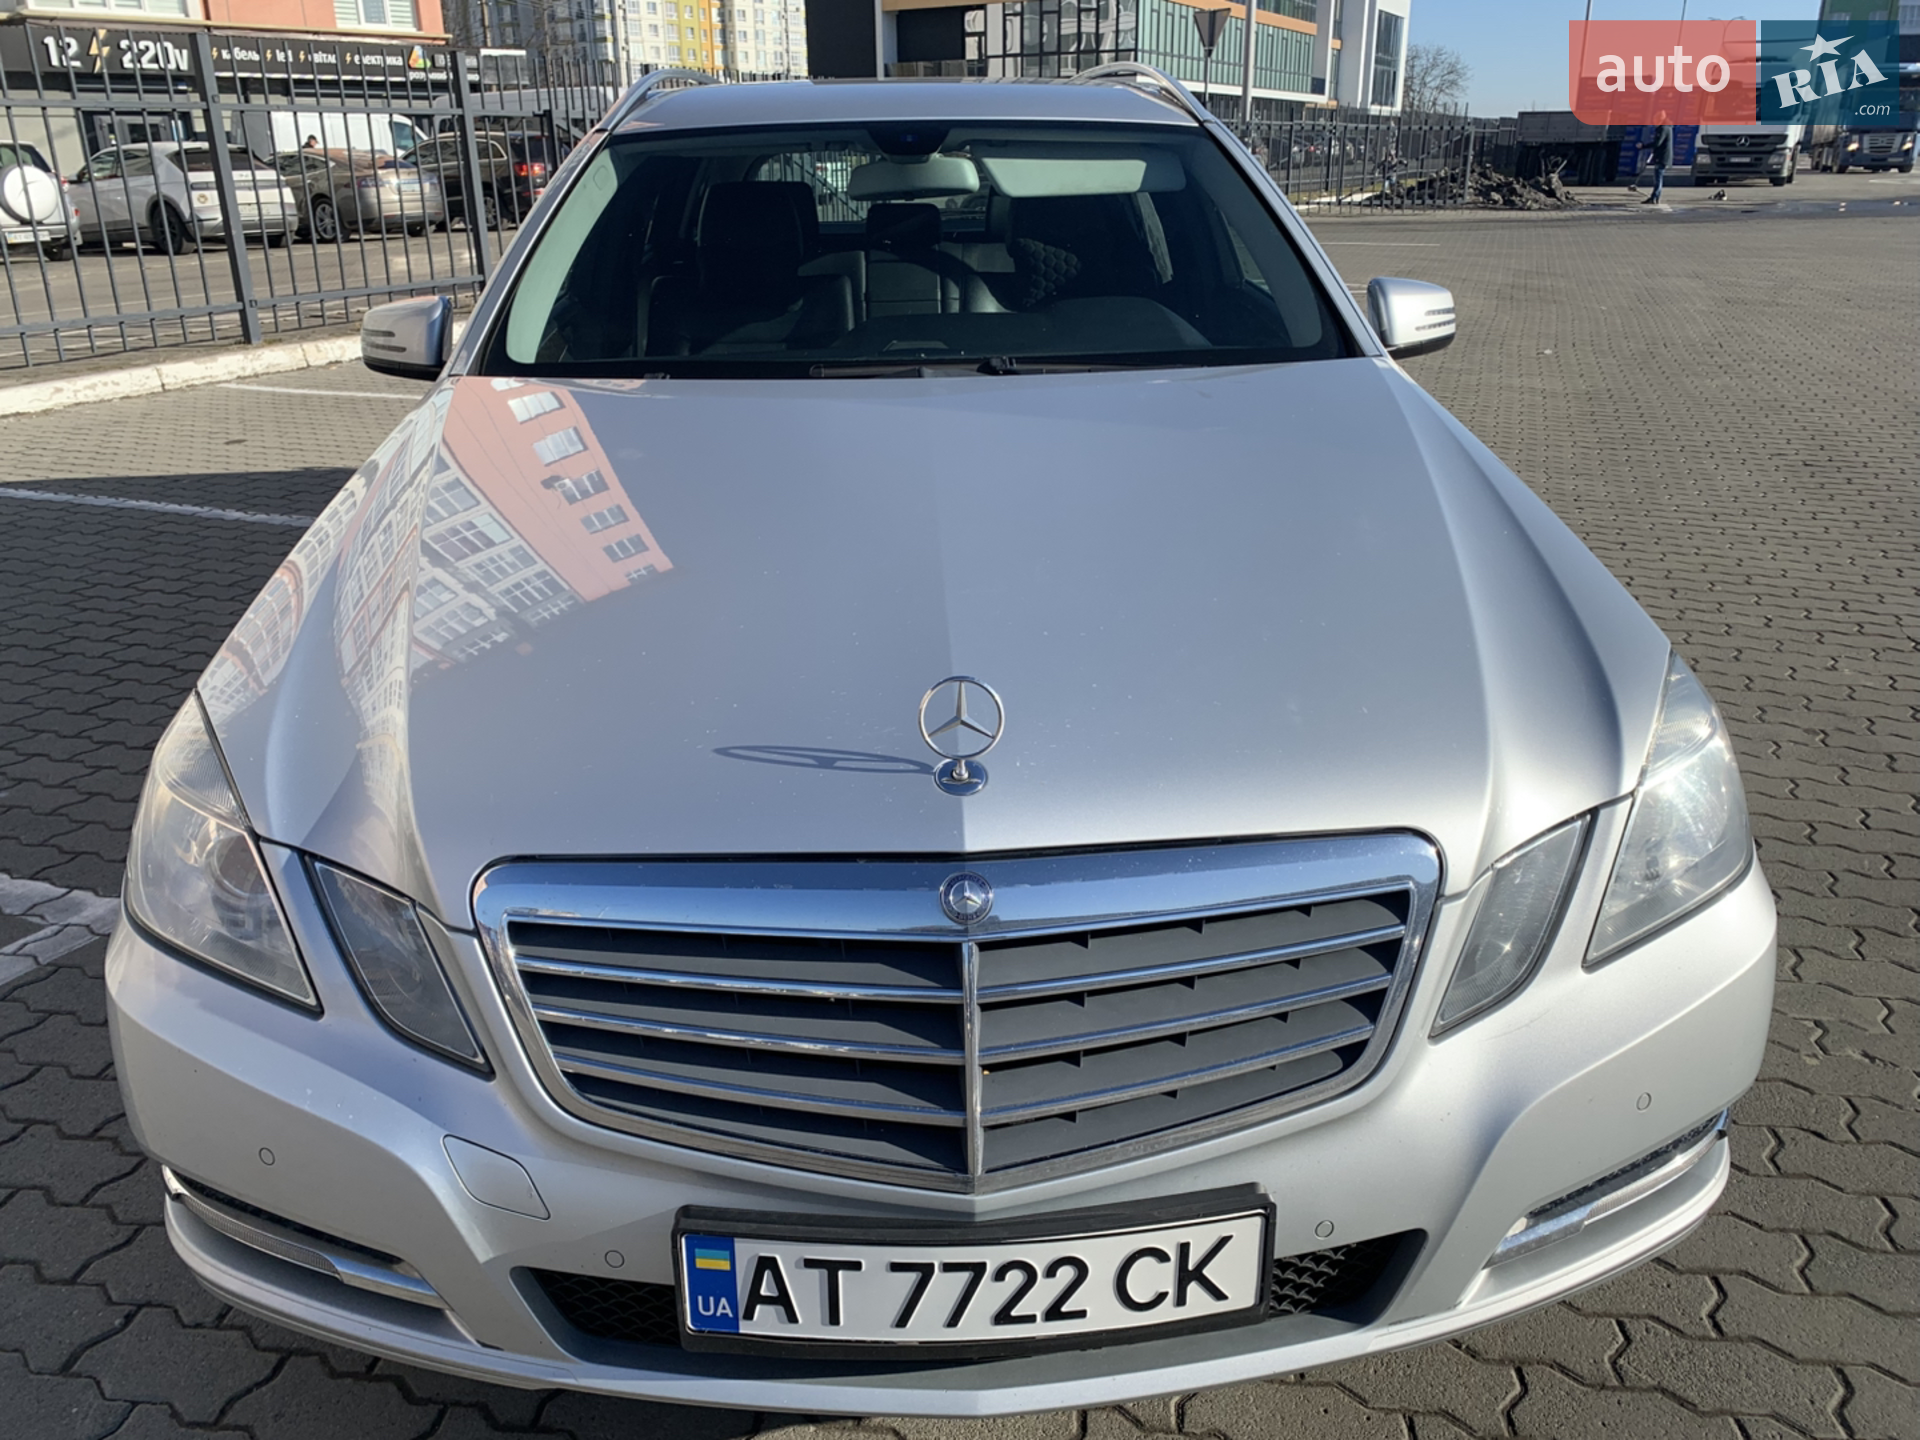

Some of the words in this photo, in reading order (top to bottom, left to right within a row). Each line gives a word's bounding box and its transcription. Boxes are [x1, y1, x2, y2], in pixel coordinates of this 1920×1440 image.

[43, 36, 82, 68] 12
[742, 1254, 863, 1327] AT
[889, 1255, 1089, 1329] 7722
[1115, 1235, 1234, 1312] CK
[697, 1295, 733, 1318] UA
